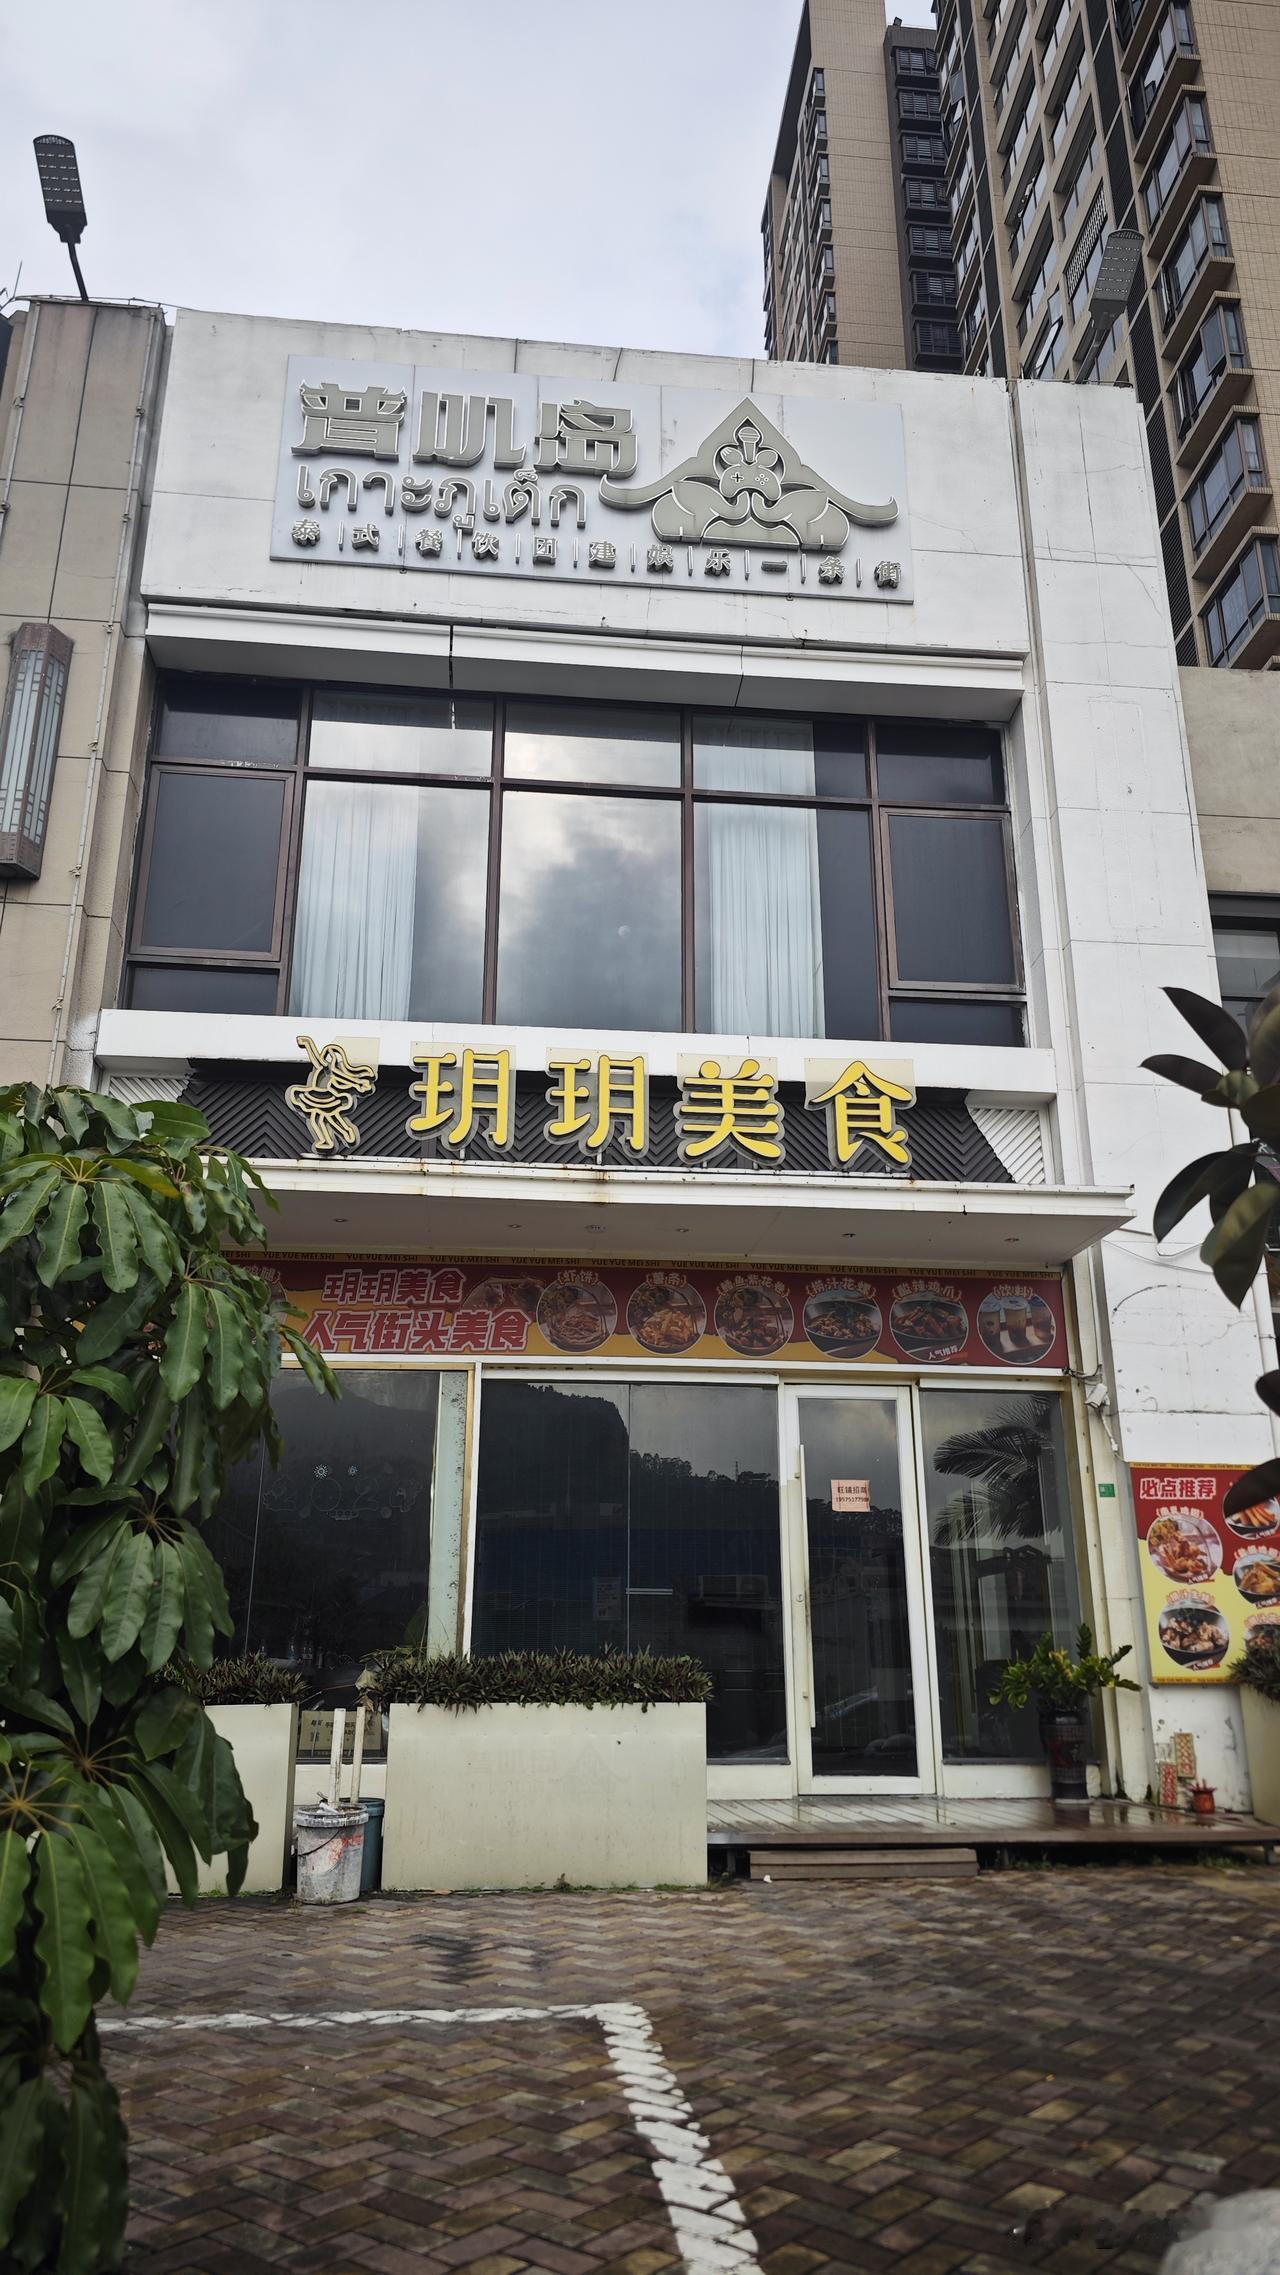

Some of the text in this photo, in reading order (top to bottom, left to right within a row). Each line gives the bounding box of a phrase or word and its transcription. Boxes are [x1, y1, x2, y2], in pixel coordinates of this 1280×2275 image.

[291, 380, 638, 478] 普叽岛
[408, 1047, 914, 1165] 玥玥美食
[322, 1268, 466, 1304] 玥玥美食
[304, 1309, 531, 1353] 人气街头美食
[1140, 1477, 1216, 1499] 必点推荐
